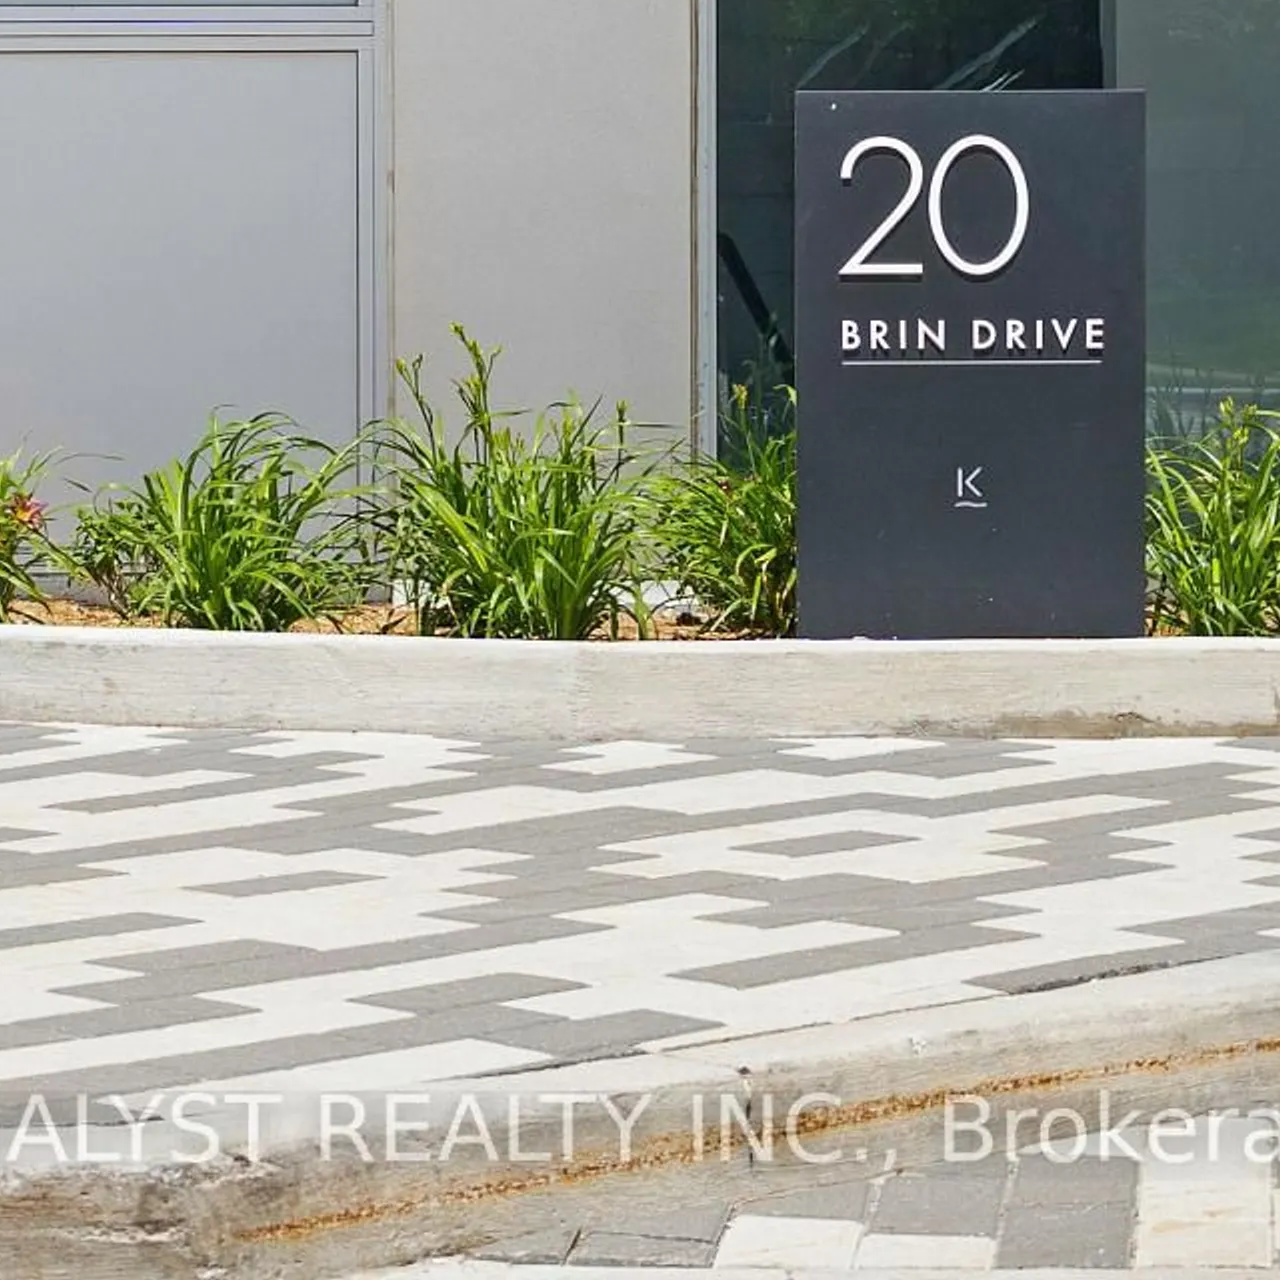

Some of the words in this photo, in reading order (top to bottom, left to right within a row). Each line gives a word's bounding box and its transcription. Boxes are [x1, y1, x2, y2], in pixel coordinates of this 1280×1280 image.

[839, 134, 1029, 276] 20
[841, 320, 946, 350] BRIN
[972, 318, 1105, 350] DRIVE
[957, 467, 983, 497] K
